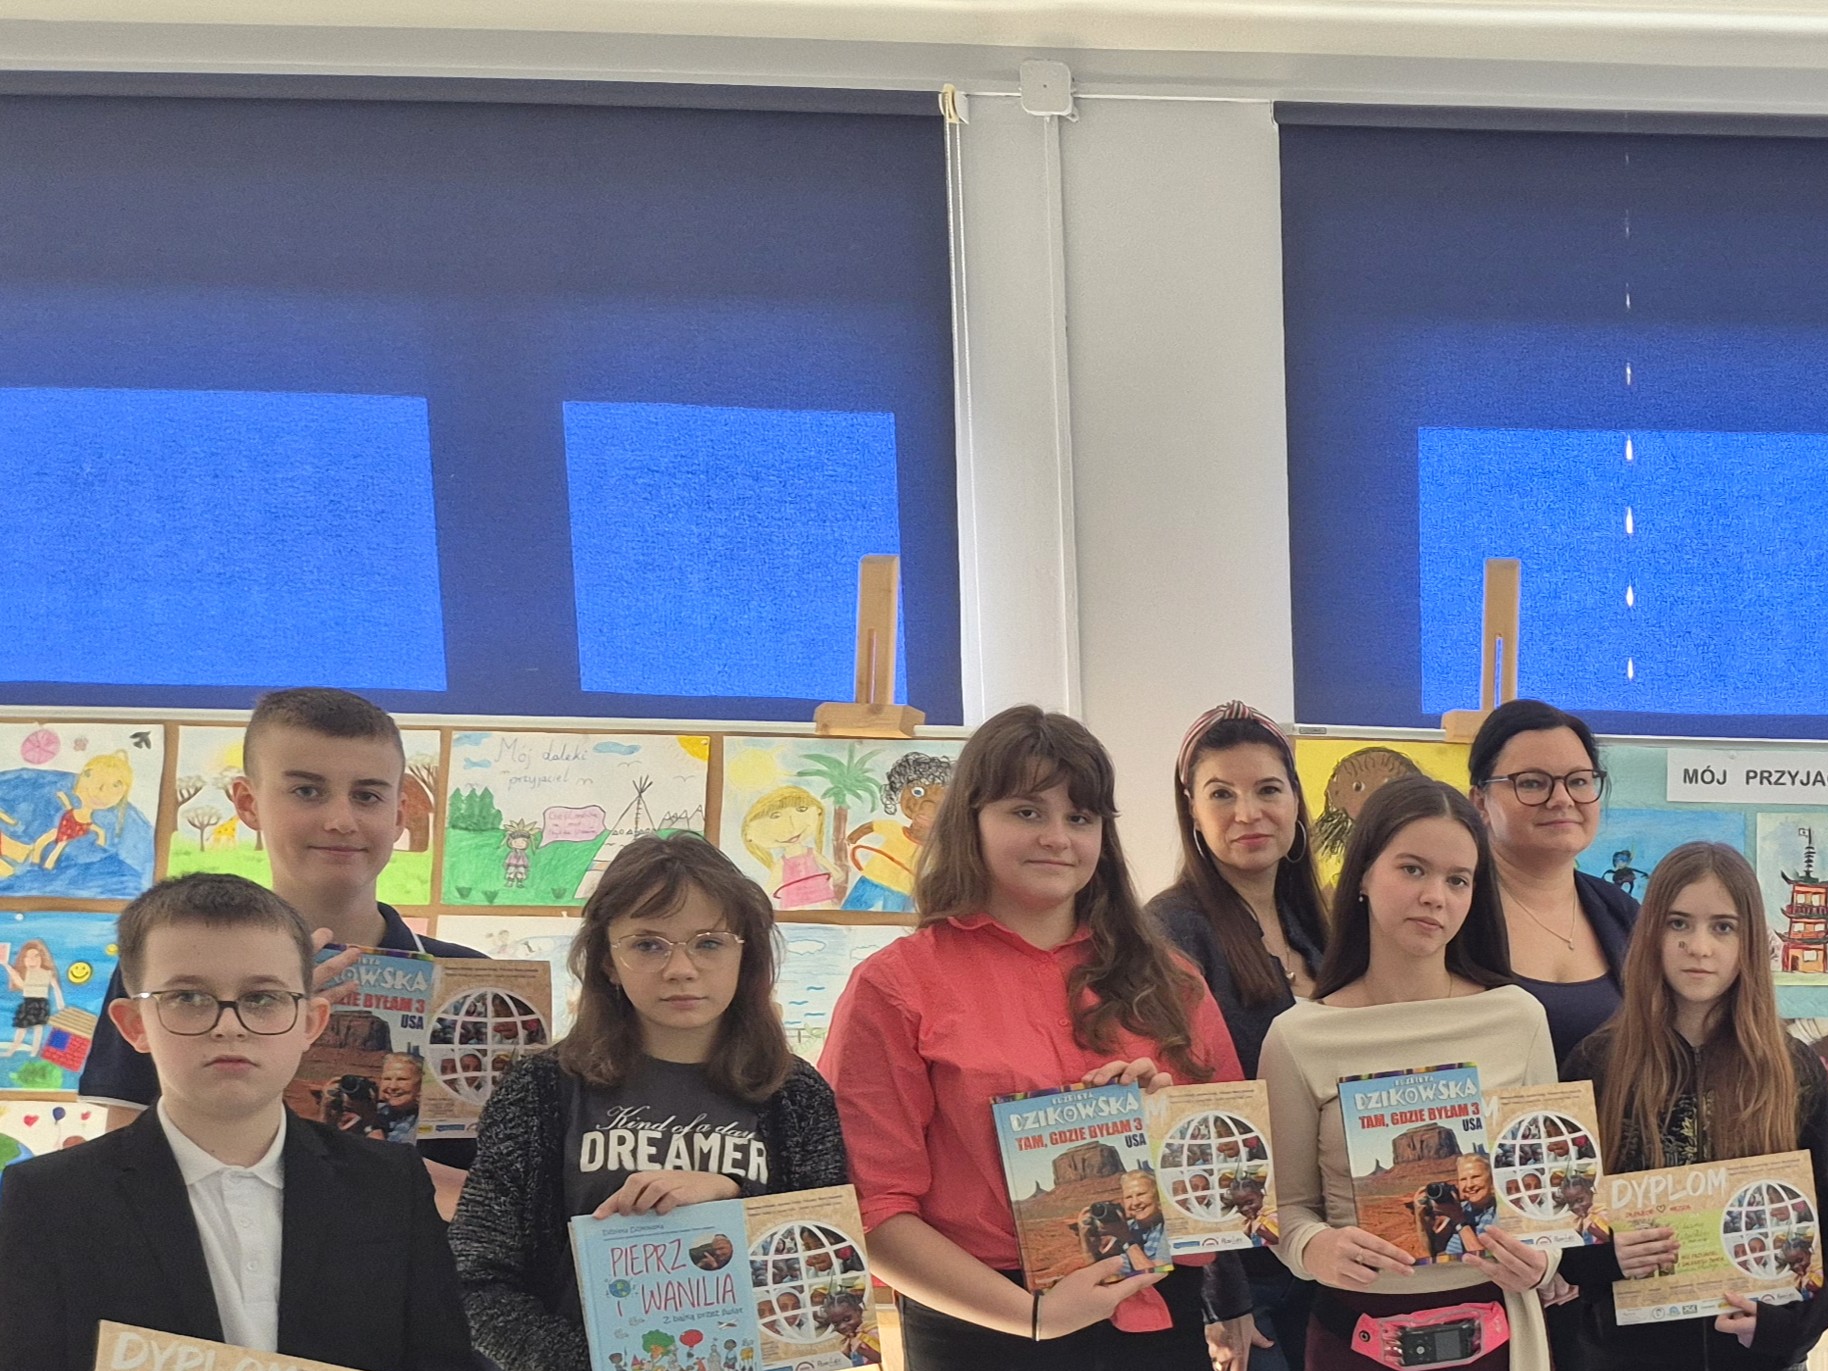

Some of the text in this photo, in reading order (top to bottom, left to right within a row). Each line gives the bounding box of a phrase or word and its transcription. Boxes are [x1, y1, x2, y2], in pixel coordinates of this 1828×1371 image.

[494, 737, 588, 769] Mój daleki
[508, 769, 569, 790] przyjaciel
[1683, 766, 1728, 786] MÓJ
[401, 1014, 424, 1030] USA
[416, 999, 425, 1014] 3
[1354, 1077, 1477, 1111] DZIKOWSKA
[596, 1105, 757, 1141] Kind of a day
[1009, 1091, 1140, 1132] DZIKOWSKA
[1358, 1115, 1390, 1130] TAM,
[1391, 1108, 1426, 1125] GDZIE
[1428, 1103, 1470, 1121] BYŁAM
[1471, 1102, 1480, 1115] 3
[1462, 1117, 1483, 1131] USA
[1015, 1117, 1143, 1151] TAM, GDZIE BYŁAM 3
[1125, 1135, 1147, 1148] USA
[579, 1129, 769, 1184] DREAMER
[1611, 1167, 1729, 1210] DYPLOM
[610, 1238, 687, 1278] PIEPRZ
[641, 1273, 737, 1316] WANILIA
